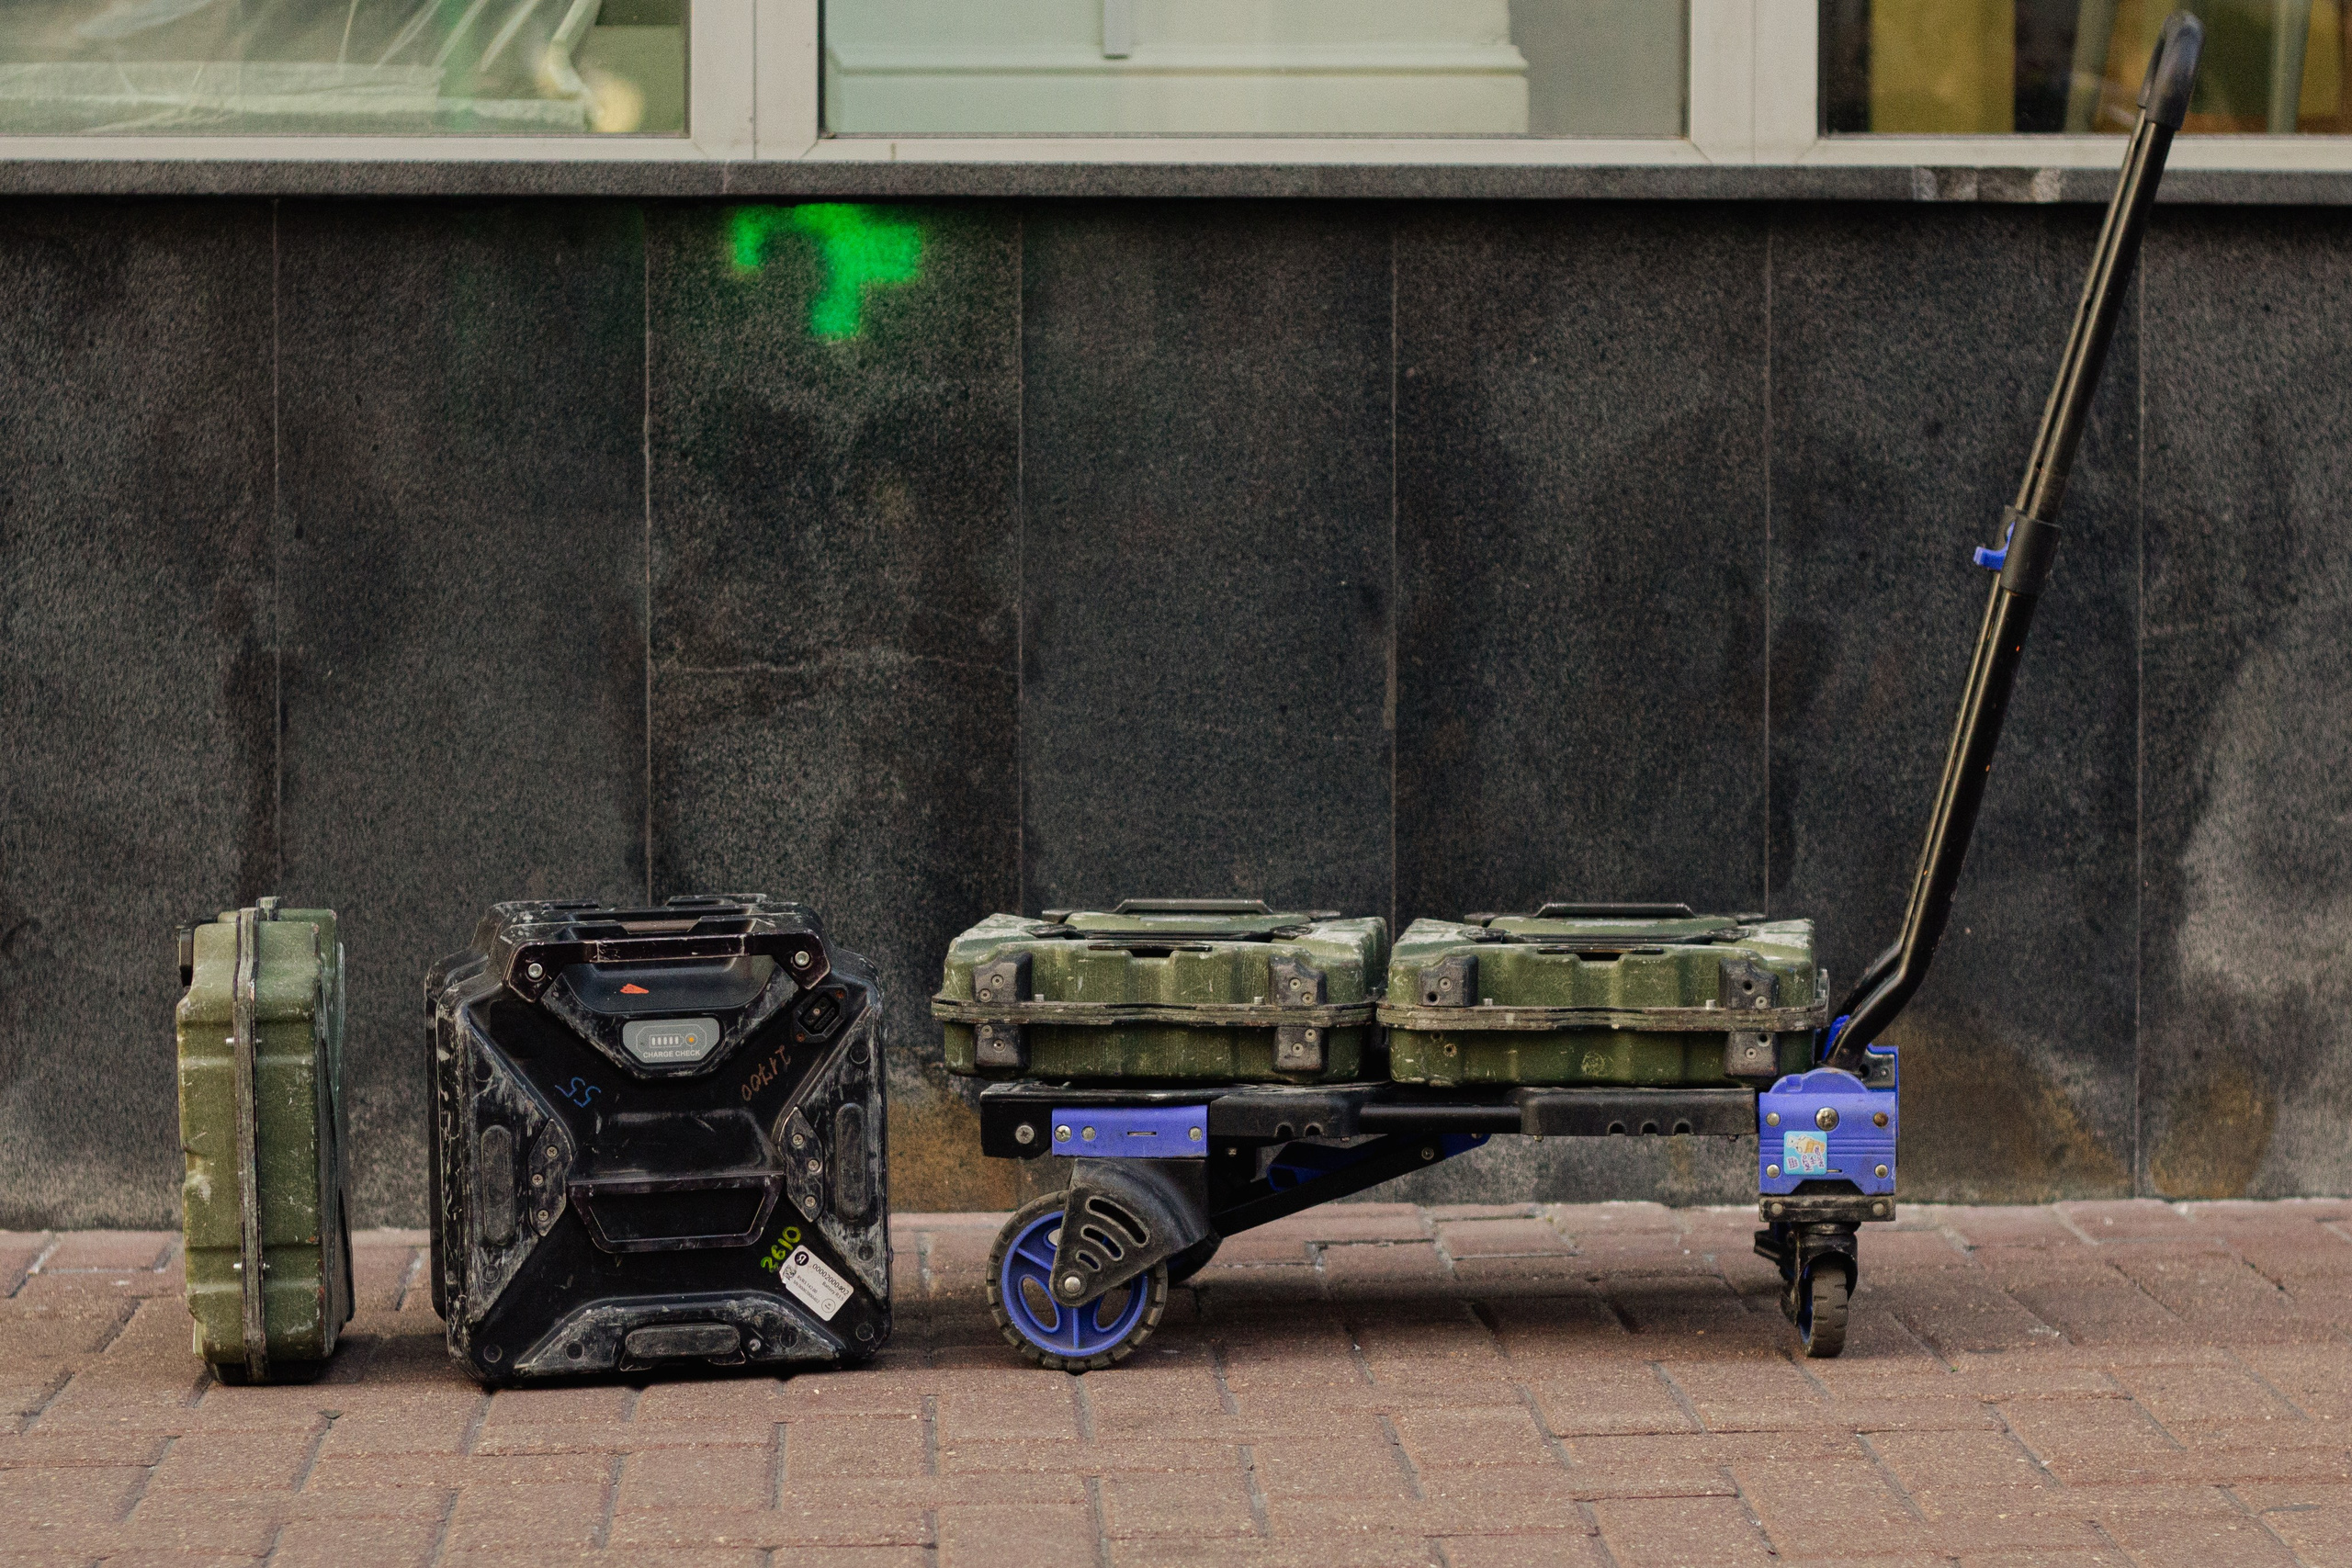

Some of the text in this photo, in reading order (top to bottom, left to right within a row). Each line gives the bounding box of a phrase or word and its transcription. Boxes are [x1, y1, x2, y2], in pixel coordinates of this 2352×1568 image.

[643, 1049, 701, 1058] CHARGE CHECK
[760, 1226, 801, 1273] 2610
[812, 1263, 850, 1296] 00002000402
[821, 1281, 835, 1294] Battery
